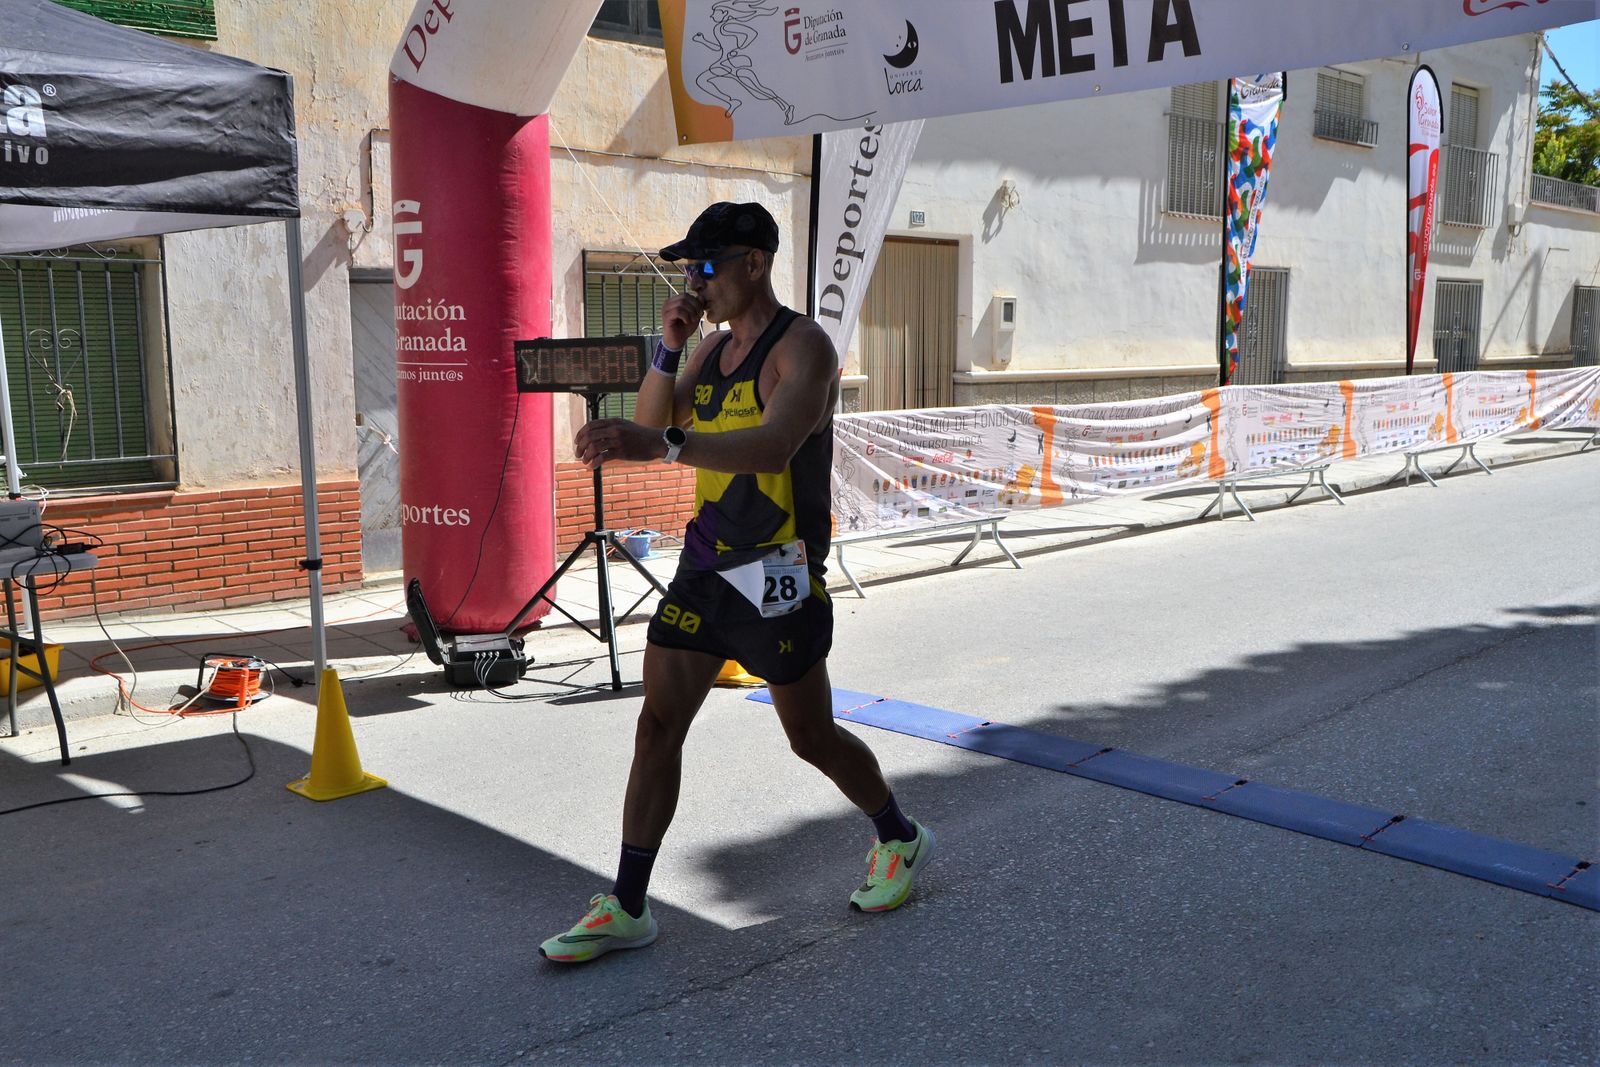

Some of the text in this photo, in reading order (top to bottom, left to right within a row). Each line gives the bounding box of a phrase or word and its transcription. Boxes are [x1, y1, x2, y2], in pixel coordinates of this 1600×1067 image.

[804, 11, 843, 30] Diputación
[804, 24, 847, 46] de Granada
[763, 575, 798, 603] 28
[661, 604, 702, 635] 90
